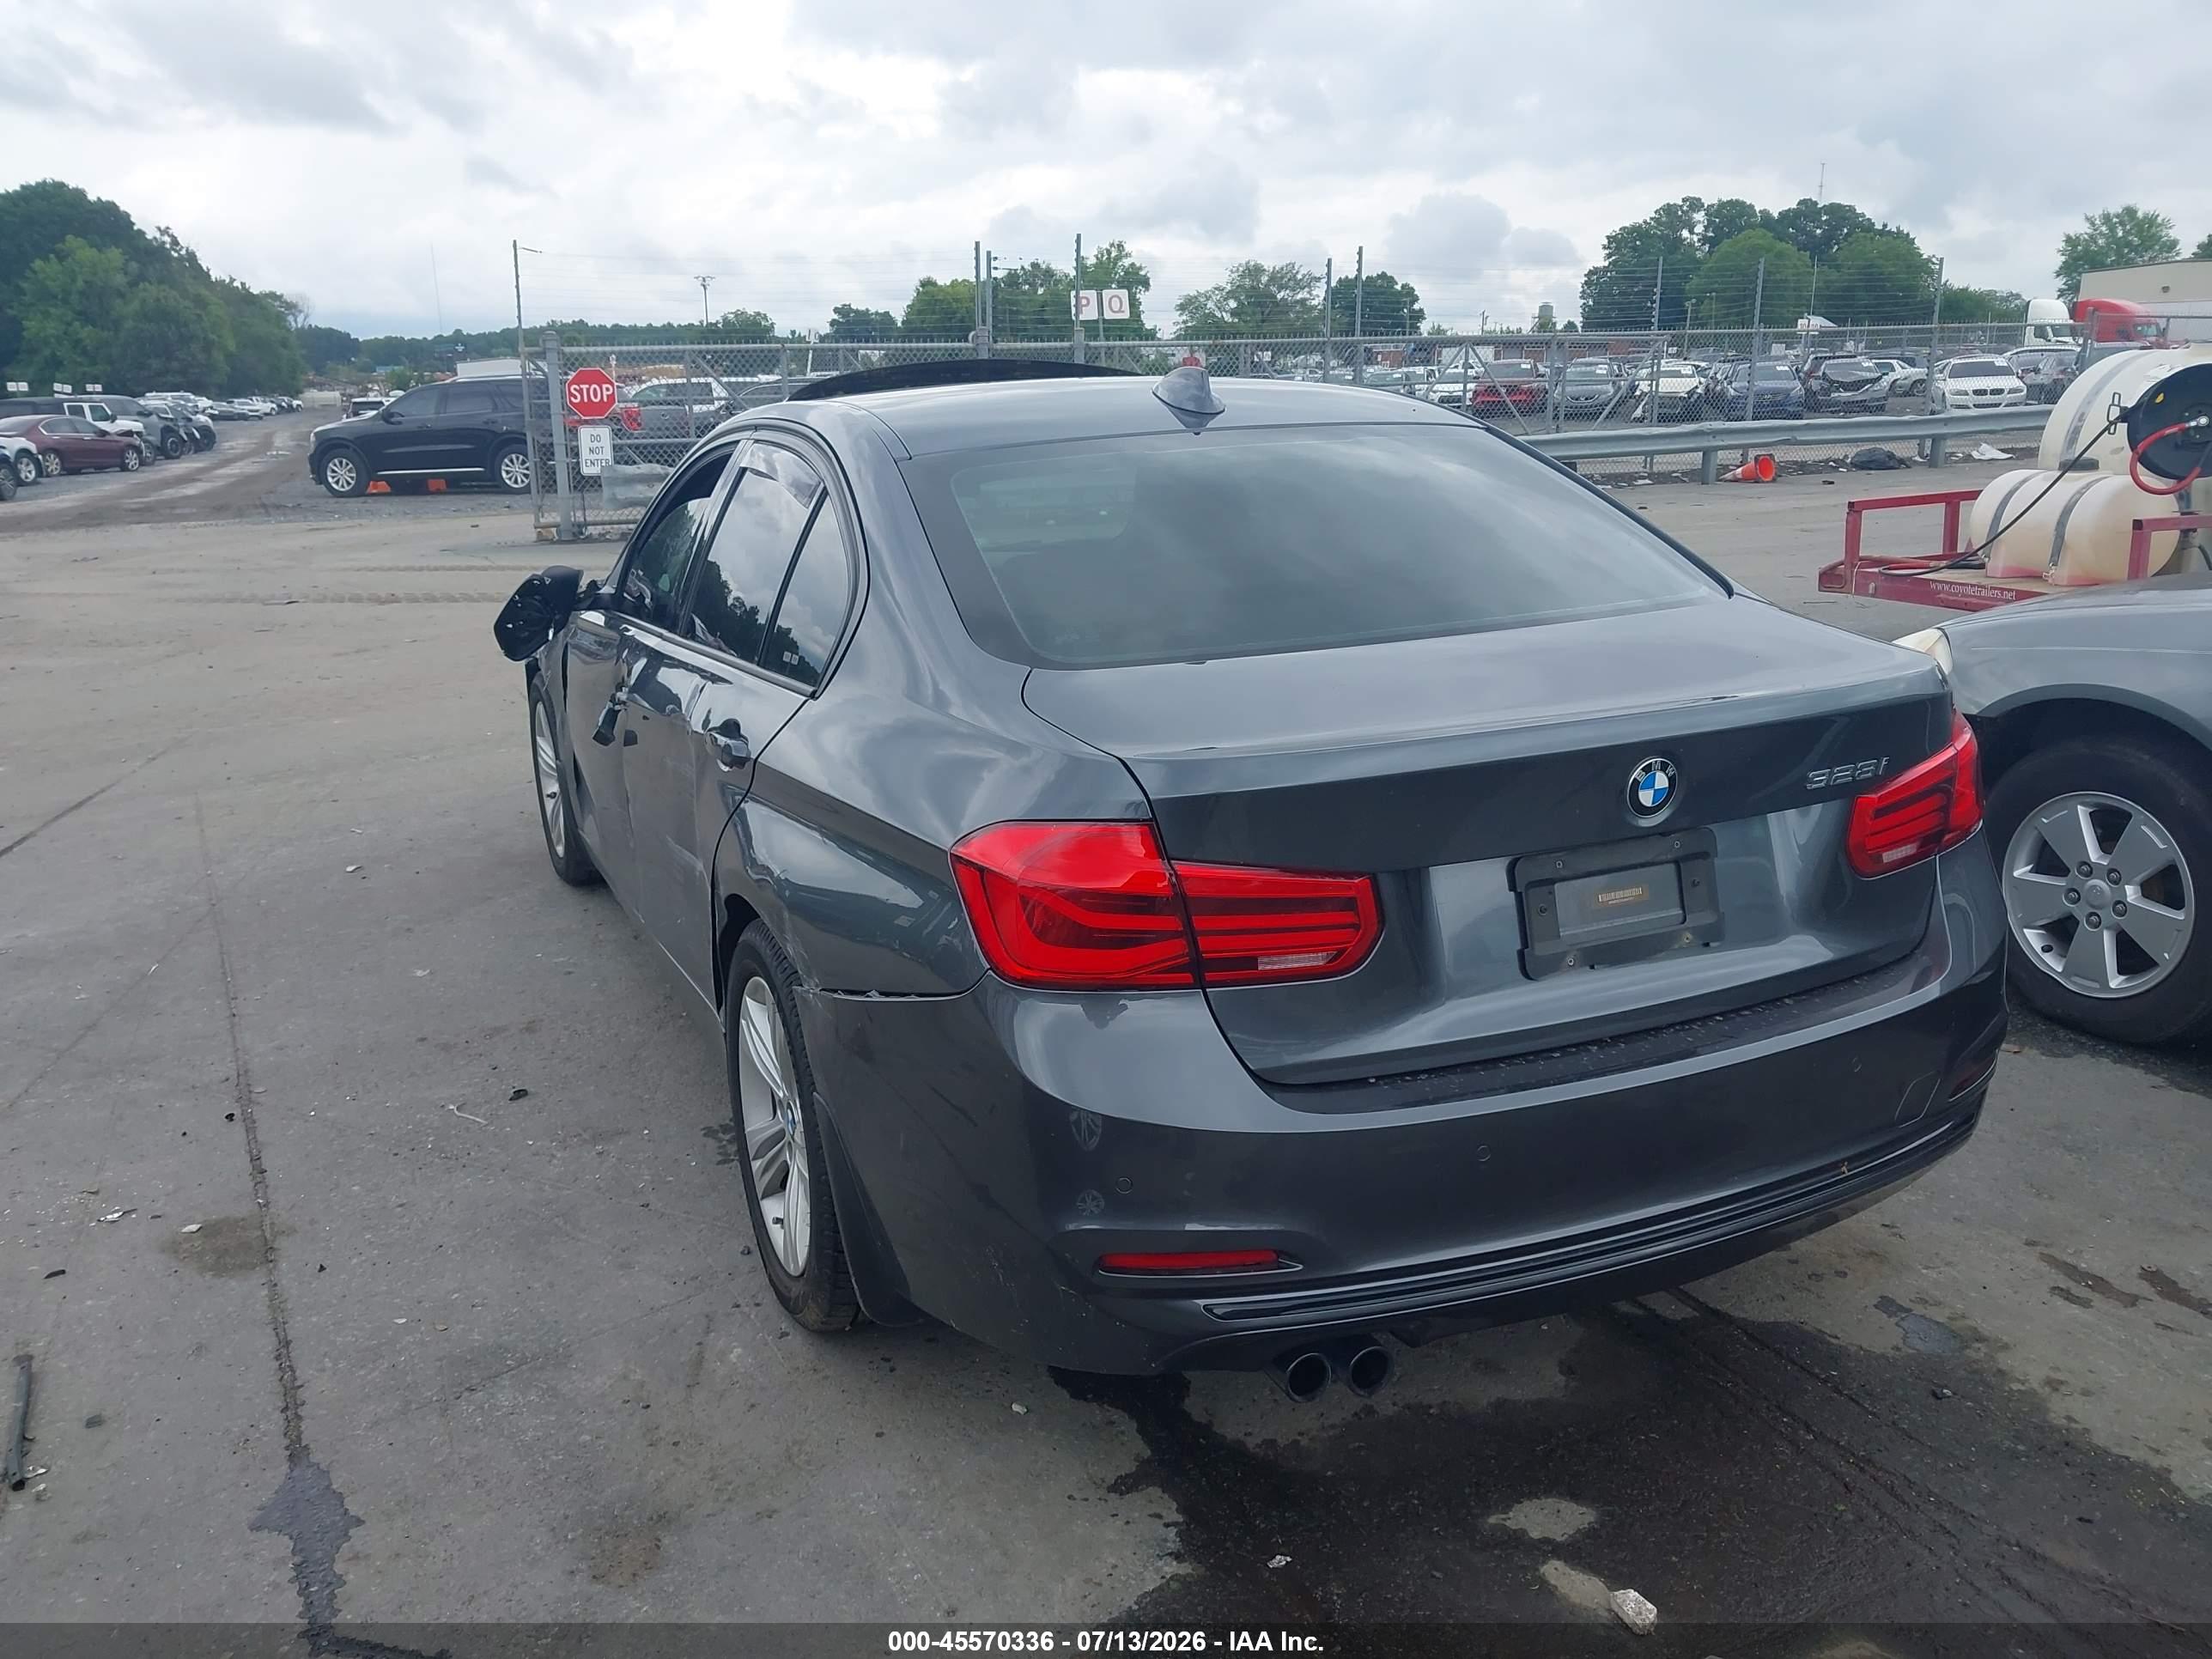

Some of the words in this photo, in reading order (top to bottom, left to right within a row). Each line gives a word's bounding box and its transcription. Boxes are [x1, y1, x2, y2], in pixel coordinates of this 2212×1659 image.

[1079, 295, 1091, 315] P
[1108, 295, 1125, 314] Q
[569, 384, 613, 403] STOP
[590, 434, 601, 443] DO
[589, 447, 605, 455] NOT
[585, 459, 611, 468] ENTER
[1929, 580, 2016, 600] www.coyotetrailers.net
[1634, 760, 1675, 782] BMW
[1806, 757, 1889, 790] 328i
